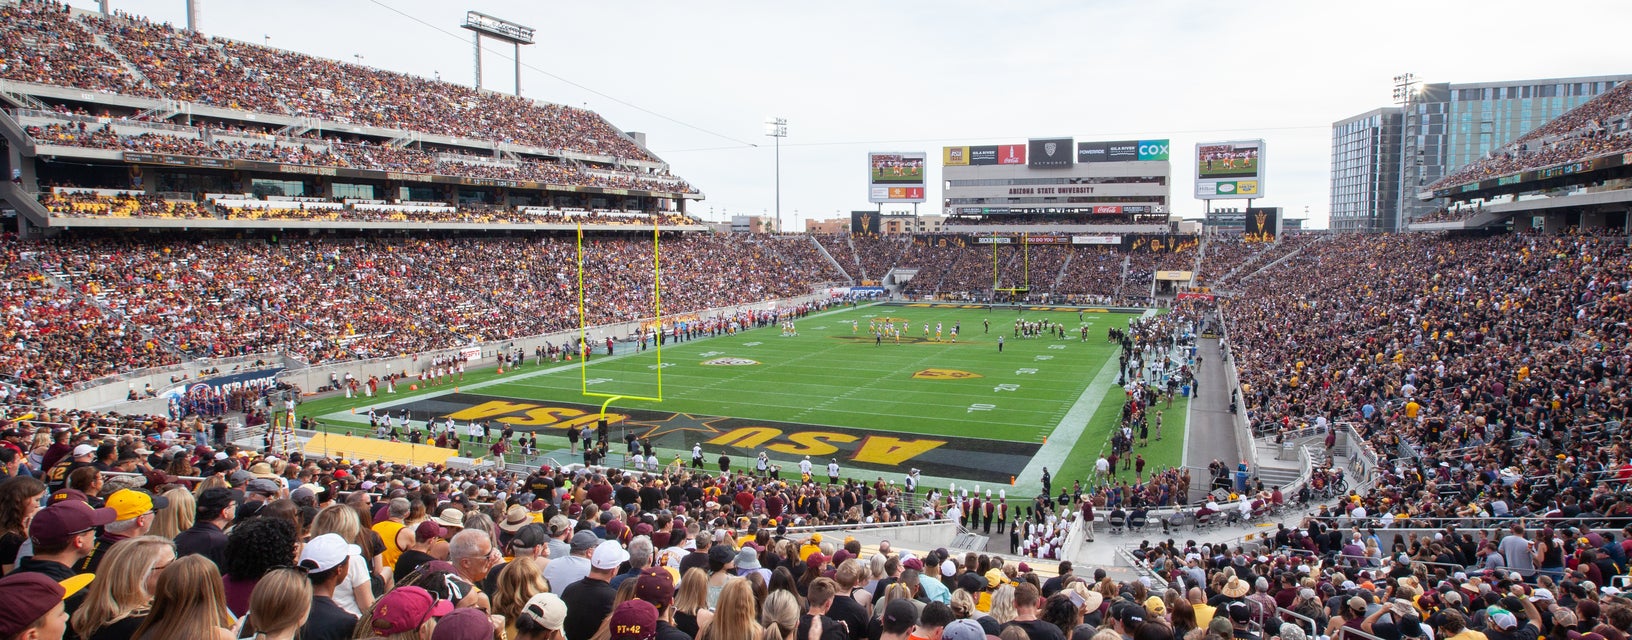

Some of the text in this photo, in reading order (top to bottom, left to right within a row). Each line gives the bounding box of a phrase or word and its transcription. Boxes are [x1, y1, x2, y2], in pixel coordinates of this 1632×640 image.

[1139, 144, 1169, 155] COX
[1058, 186, 1095, 194] UNIVERSITY
[703, 426, 949, 466] ASU
